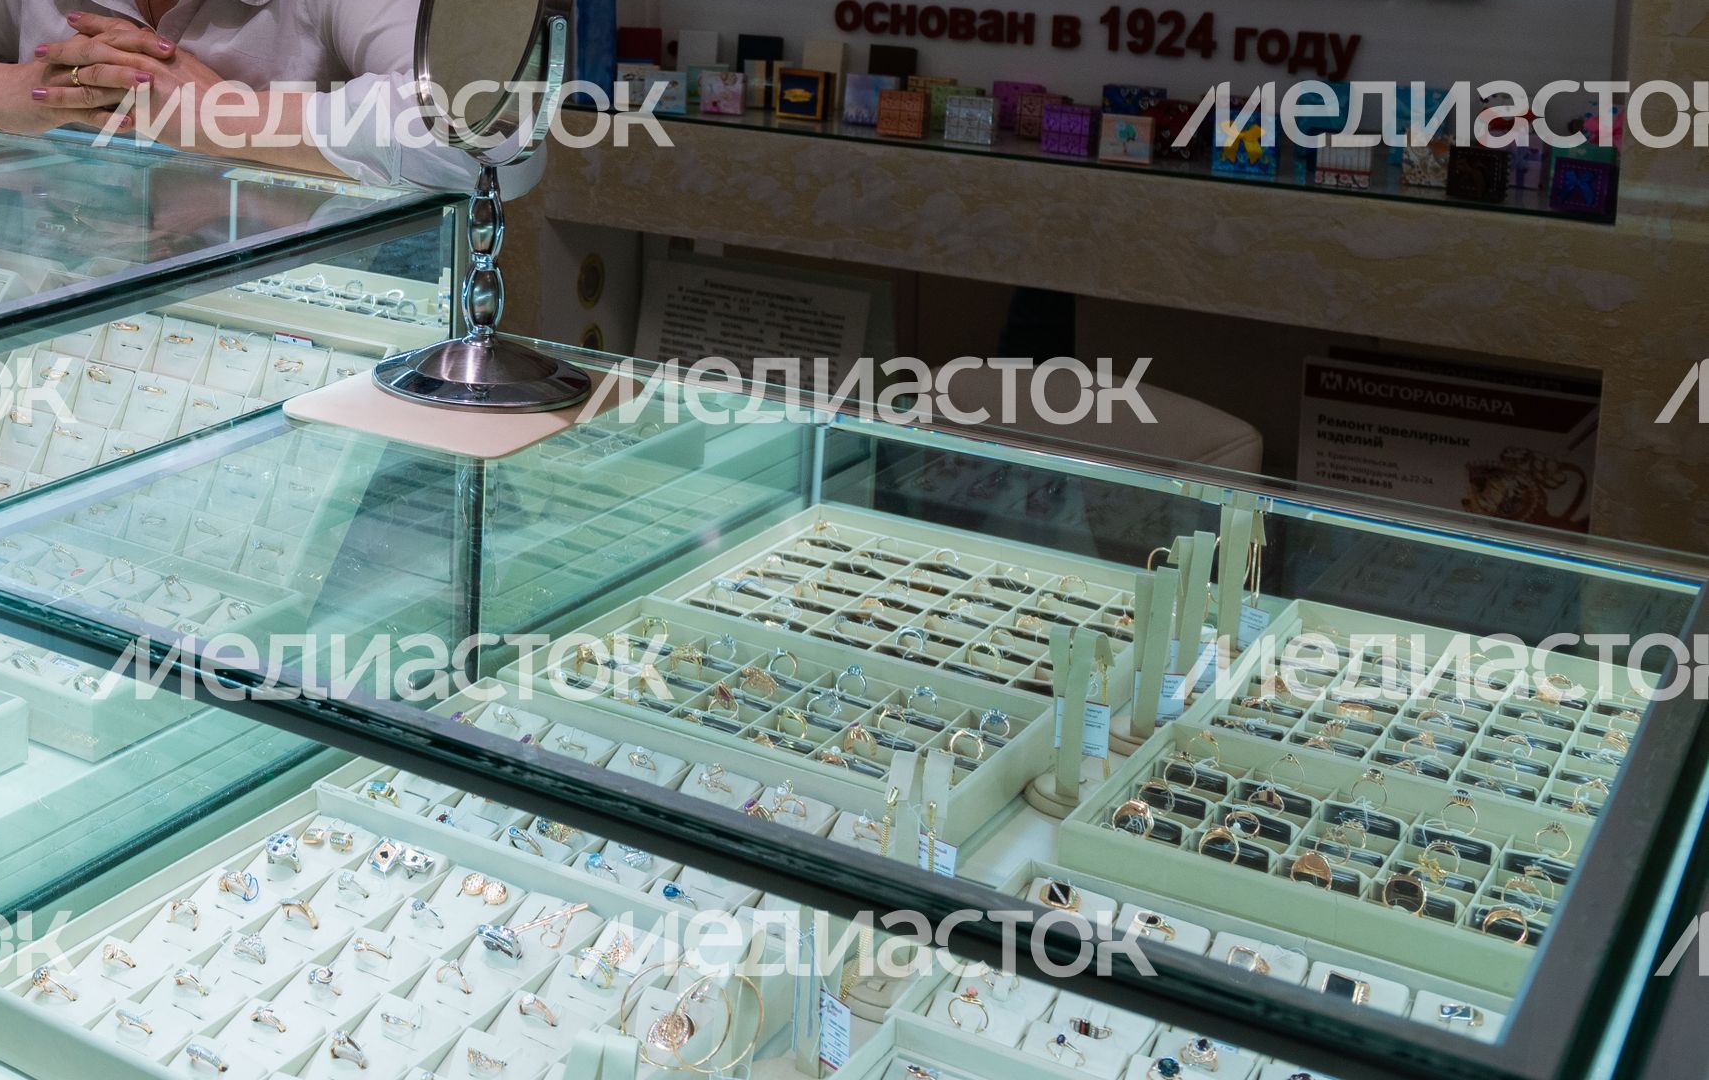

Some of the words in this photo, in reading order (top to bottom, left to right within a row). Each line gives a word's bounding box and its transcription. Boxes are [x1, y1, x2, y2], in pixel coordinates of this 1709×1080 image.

[1051, 15, 1082, 50] в
[1099, 5, 1218, 60] 1924
[1233, 24, 1363, 83] году
[1316, 429, 1384, 449] изделий
[1317, 413, 1373, 433] Ремонт
[1377, 424, 1470, 448] ювелирных
